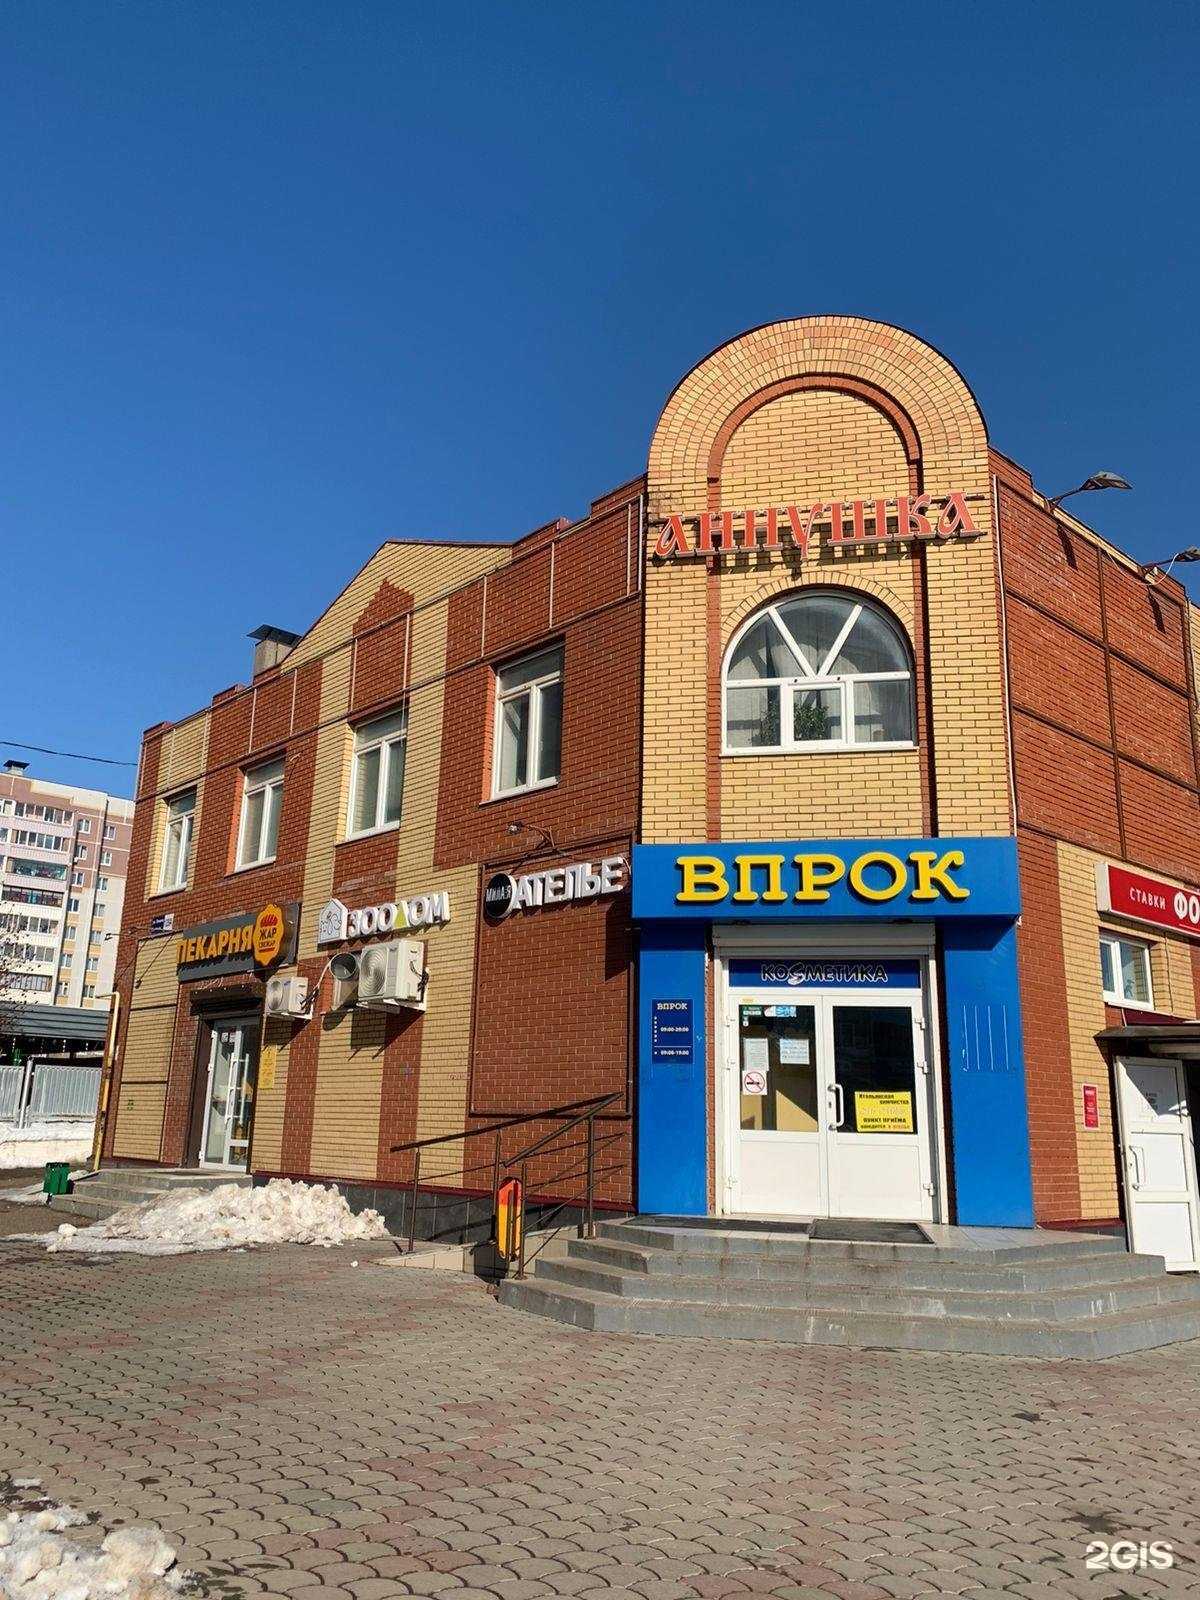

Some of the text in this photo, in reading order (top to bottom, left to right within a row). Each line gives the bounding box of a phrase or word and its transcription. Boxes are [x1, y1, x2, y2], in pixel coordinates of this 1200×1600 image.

[654, 491, 980, 558] АННУШКА
[511, 856, 624, 910] АТЕЛЬЕ
[676, 850, 970, 902] ВПРОК
[1129, 887, 1166, 910] СТАВКИ
[176, 925, 254, 963] ПЕКАРНЯ
[259, 926, 277, 941] ЖАР
[656, 1002, 688, 1010] ВПРОК
